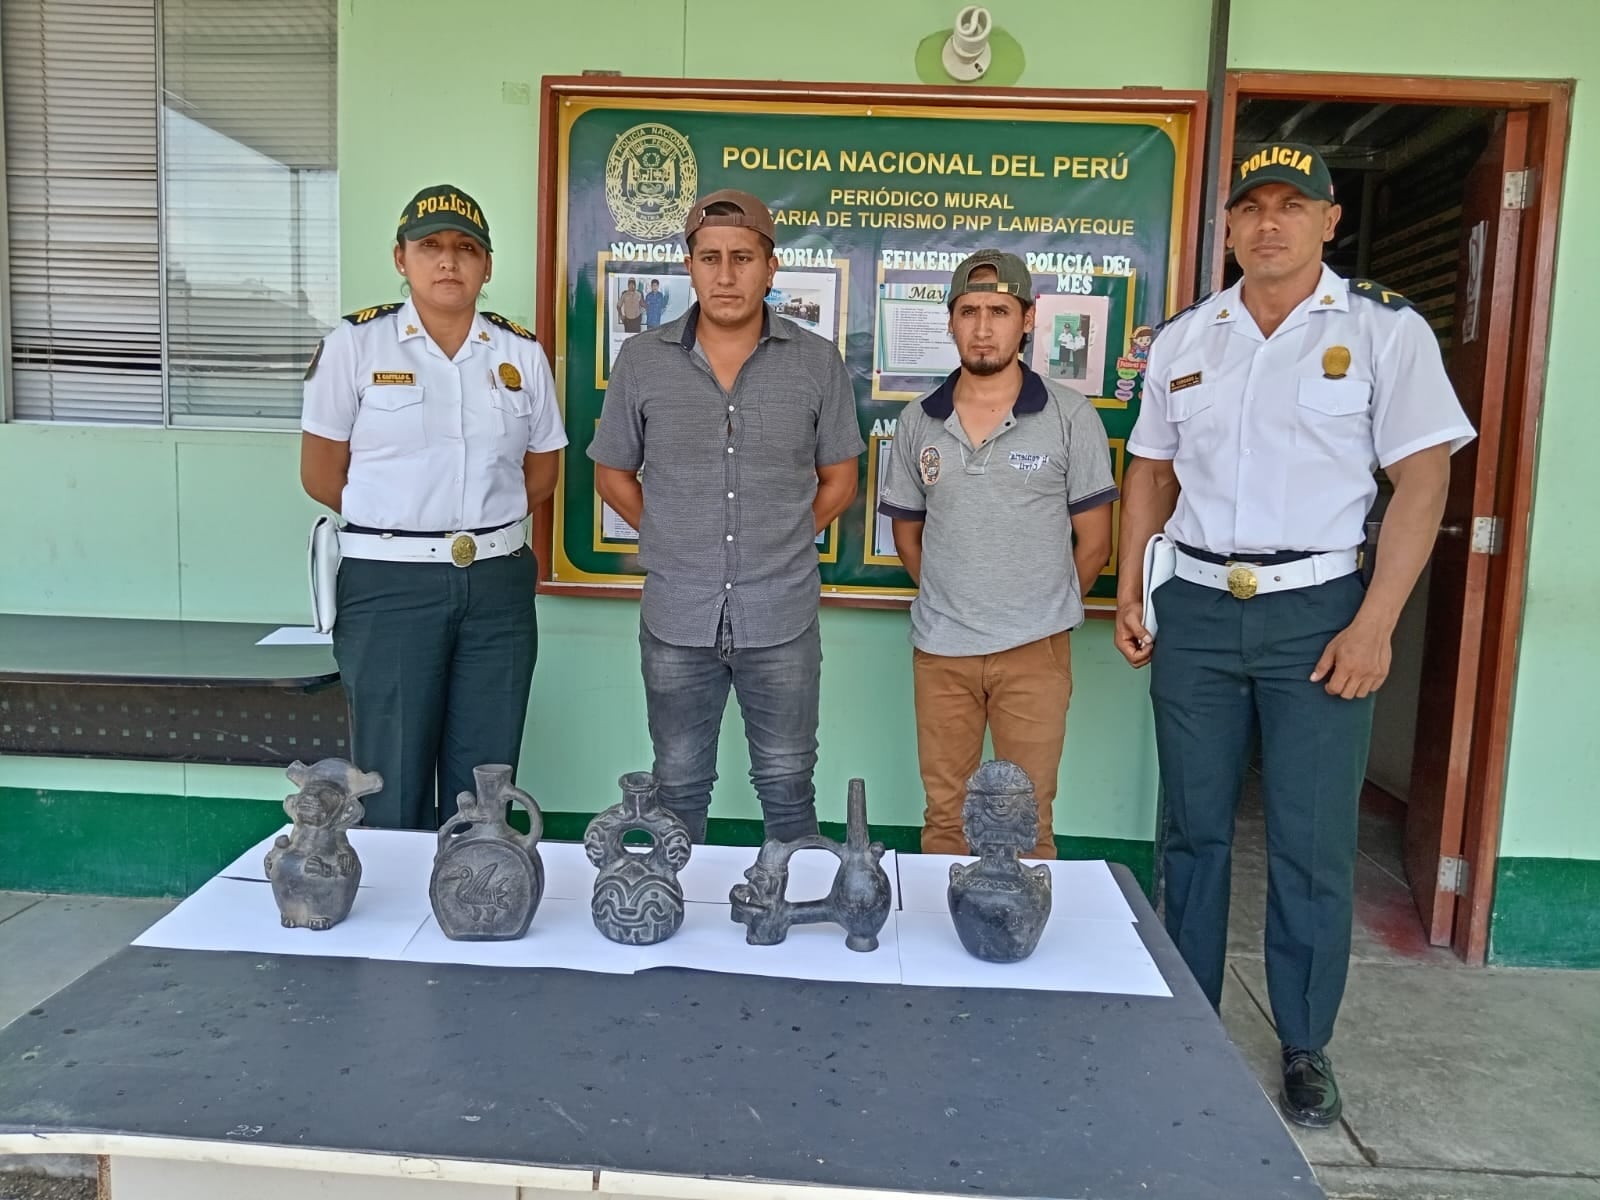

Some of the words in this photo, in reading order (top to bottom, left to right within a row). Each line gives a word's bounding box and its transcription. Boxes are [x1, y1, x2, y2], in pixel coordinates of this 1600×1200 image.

[723, 147, 831, 171] POLICIA
[839, 151, 981, 176] NACIONAL
[991, 155, 1044, 177] DEL
[1053, 151, 1128, 180] PERÚ
[1240, 147, 1313, 180] POLICIA
[830, 186, 939, 208] PERIÓDICO
[945, 193, 1014, 210] MURAL
[416, 193, 484, 230] POLICIA
[826, 211, 852, 227] DE
[857, 212, 947, 230] TURISMO
[953, 215, 992, 231] PNP
[998, 217, 1134, 236] LAMBAYEQUE
[611, 241, 685, 263] NOTICIA
[882, 249, 974, 273] EFIMERID
[1025, 252, 1095, 275] POLICIA
[1102, 255, 1134, 277] DEL
[1056, 273, 1094, 295] MES
